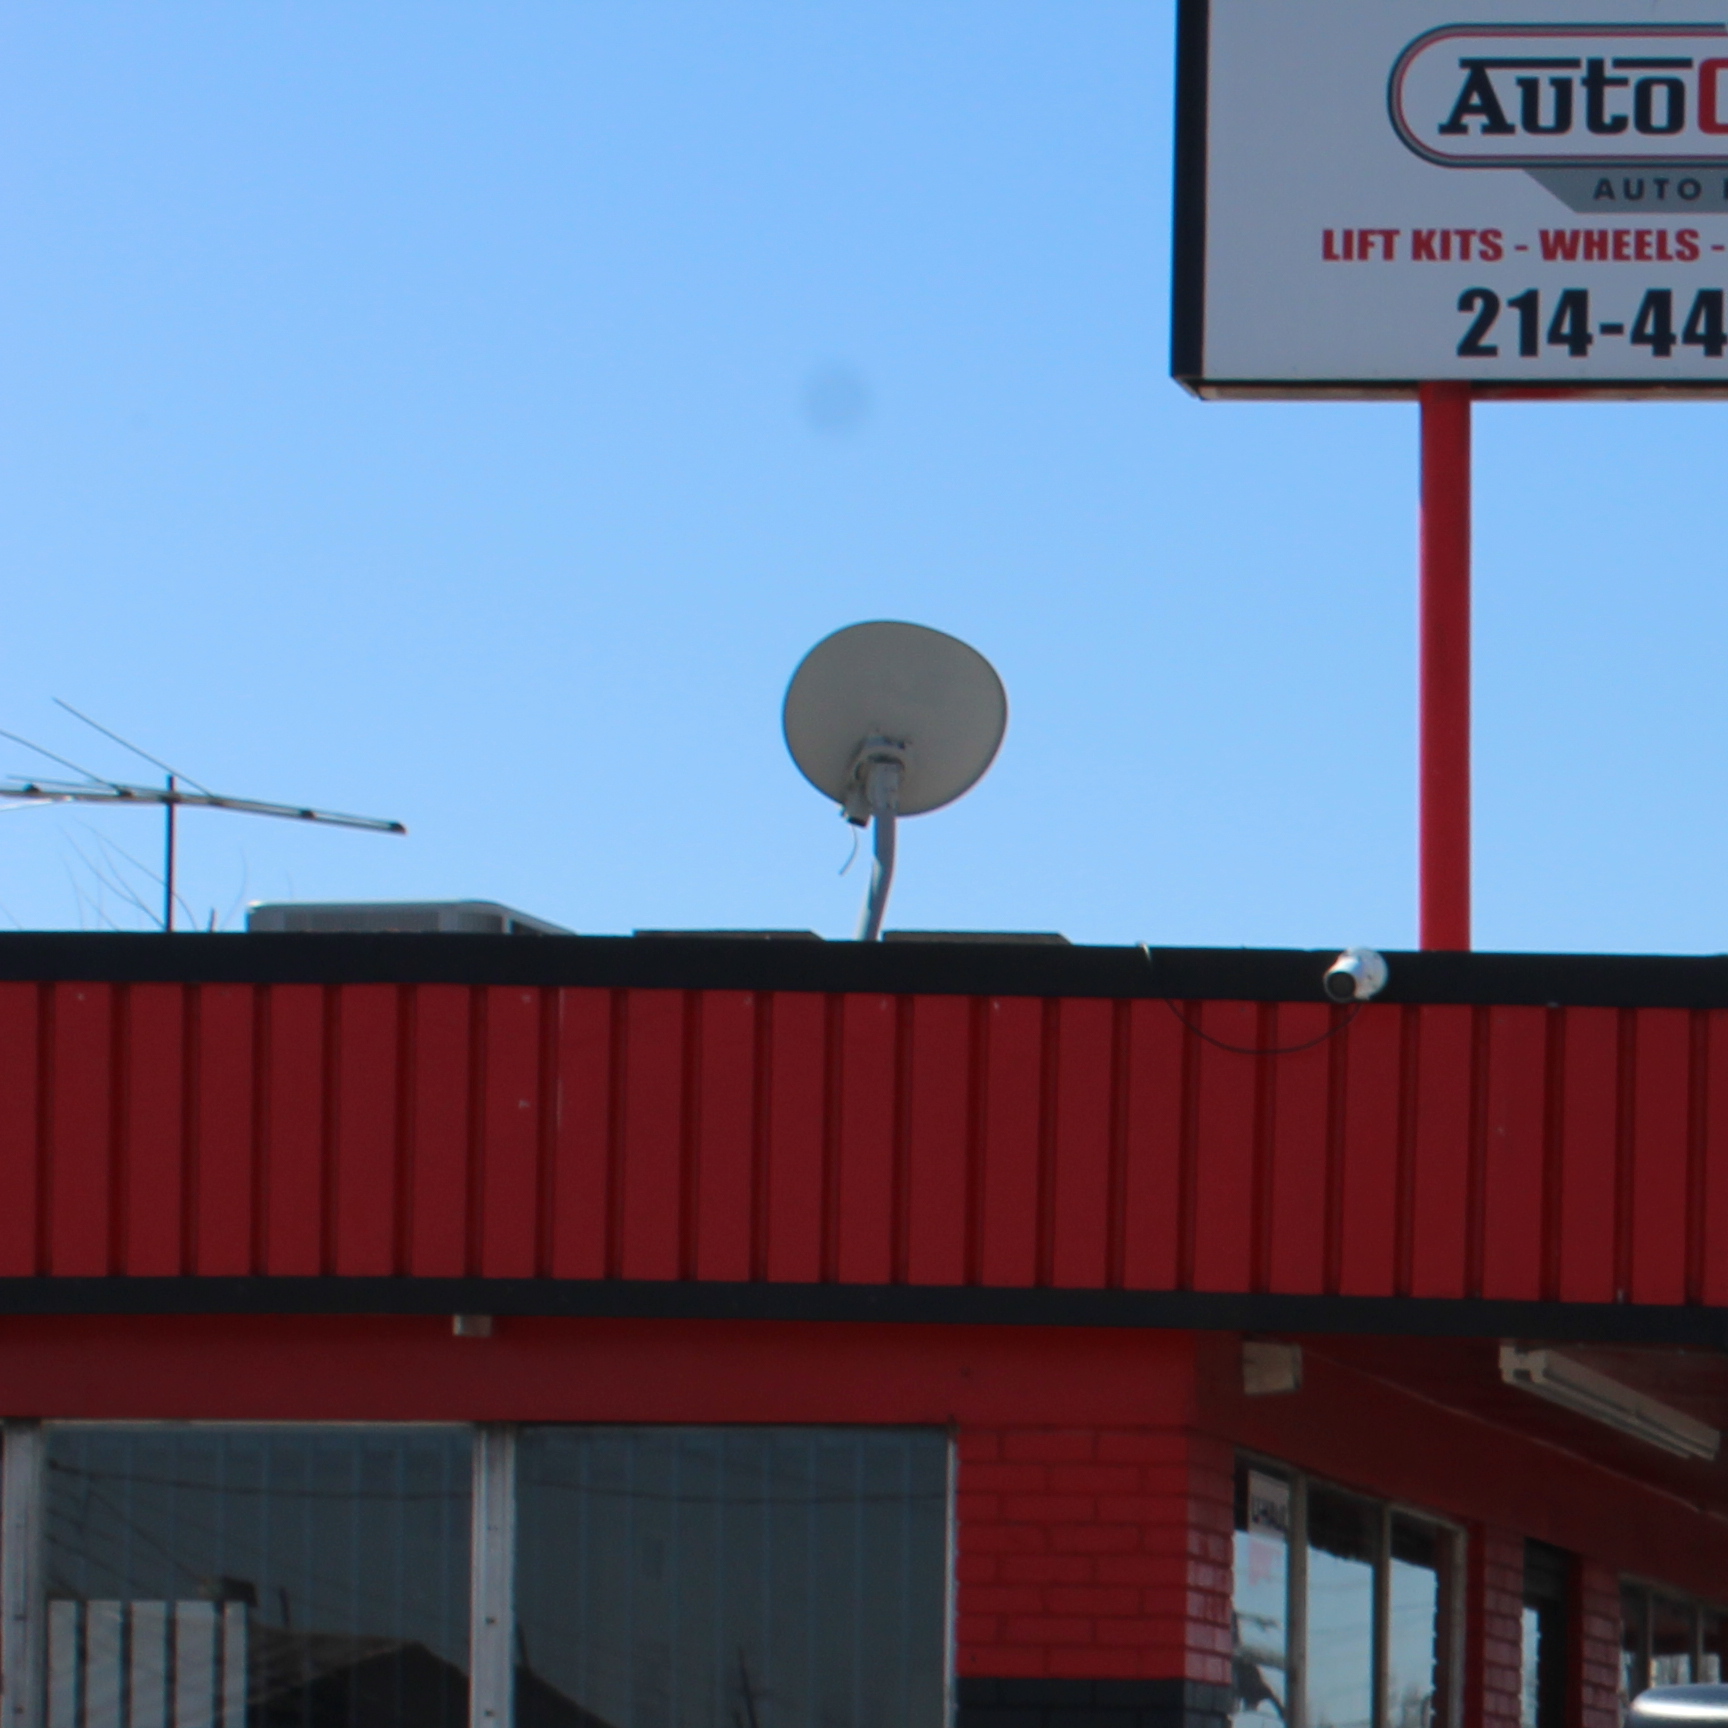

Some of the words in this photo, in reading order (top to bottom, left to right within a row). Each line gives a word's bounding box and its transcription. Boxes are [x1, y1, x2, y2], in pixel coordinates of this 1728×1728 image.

[1593, 177, 1703, 201] AUTO
[1322, 228, 1400, 261] LIFT
[1411, 228, 1503, 262] KITS
[1539, 228, 1700, 262] WHEELS
